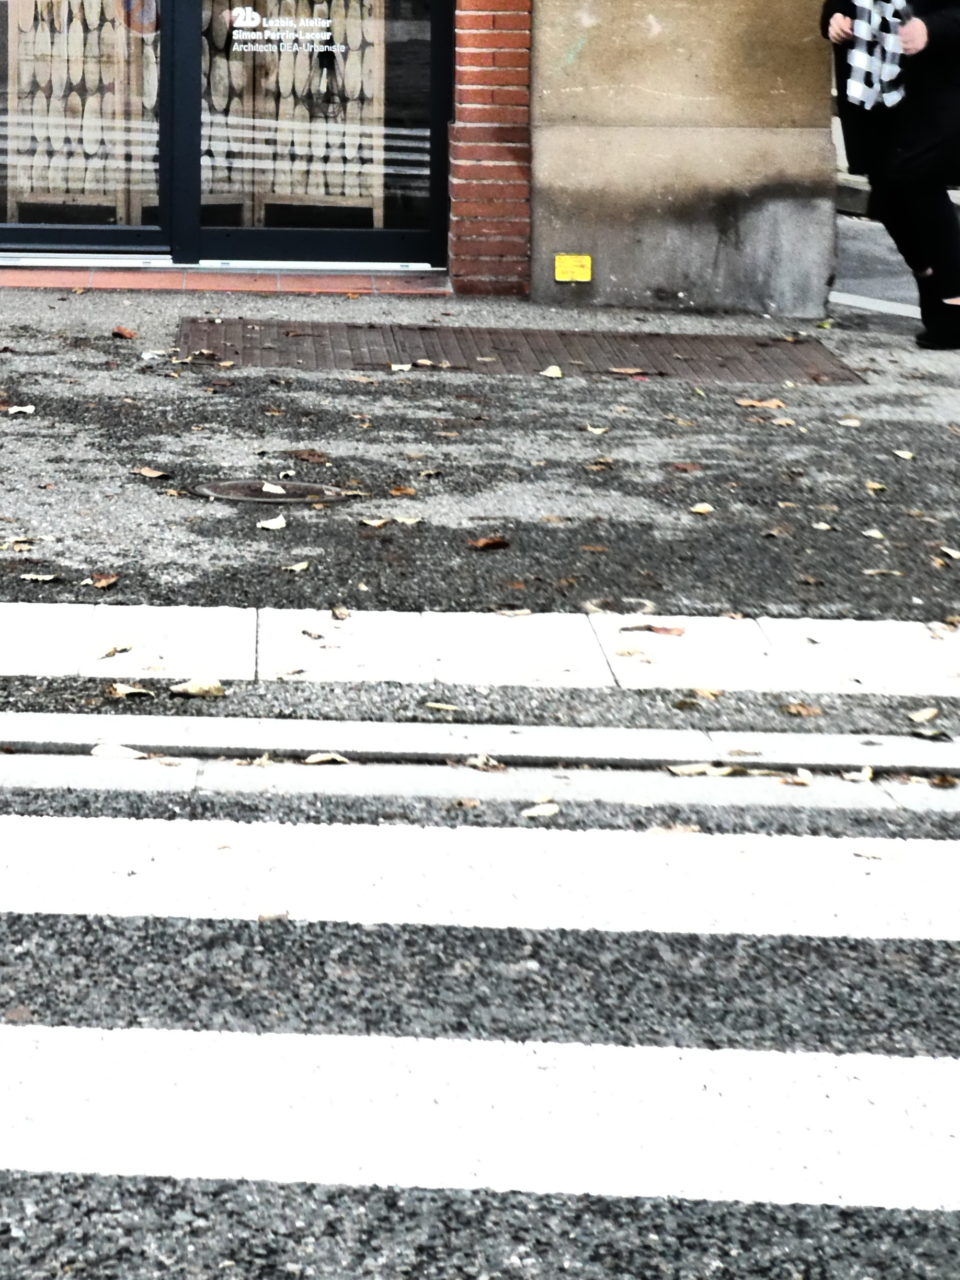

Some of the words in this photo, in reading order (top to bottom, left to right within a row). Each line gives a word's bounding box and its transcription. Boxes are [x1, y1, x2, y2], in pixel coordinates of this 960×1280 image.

[232, 6, 261, 28] 2b
[299, 17, 332, 28] Atelier
[232, 30, 262, 40] Simon
[232, 42, 278, 52] Architecte
